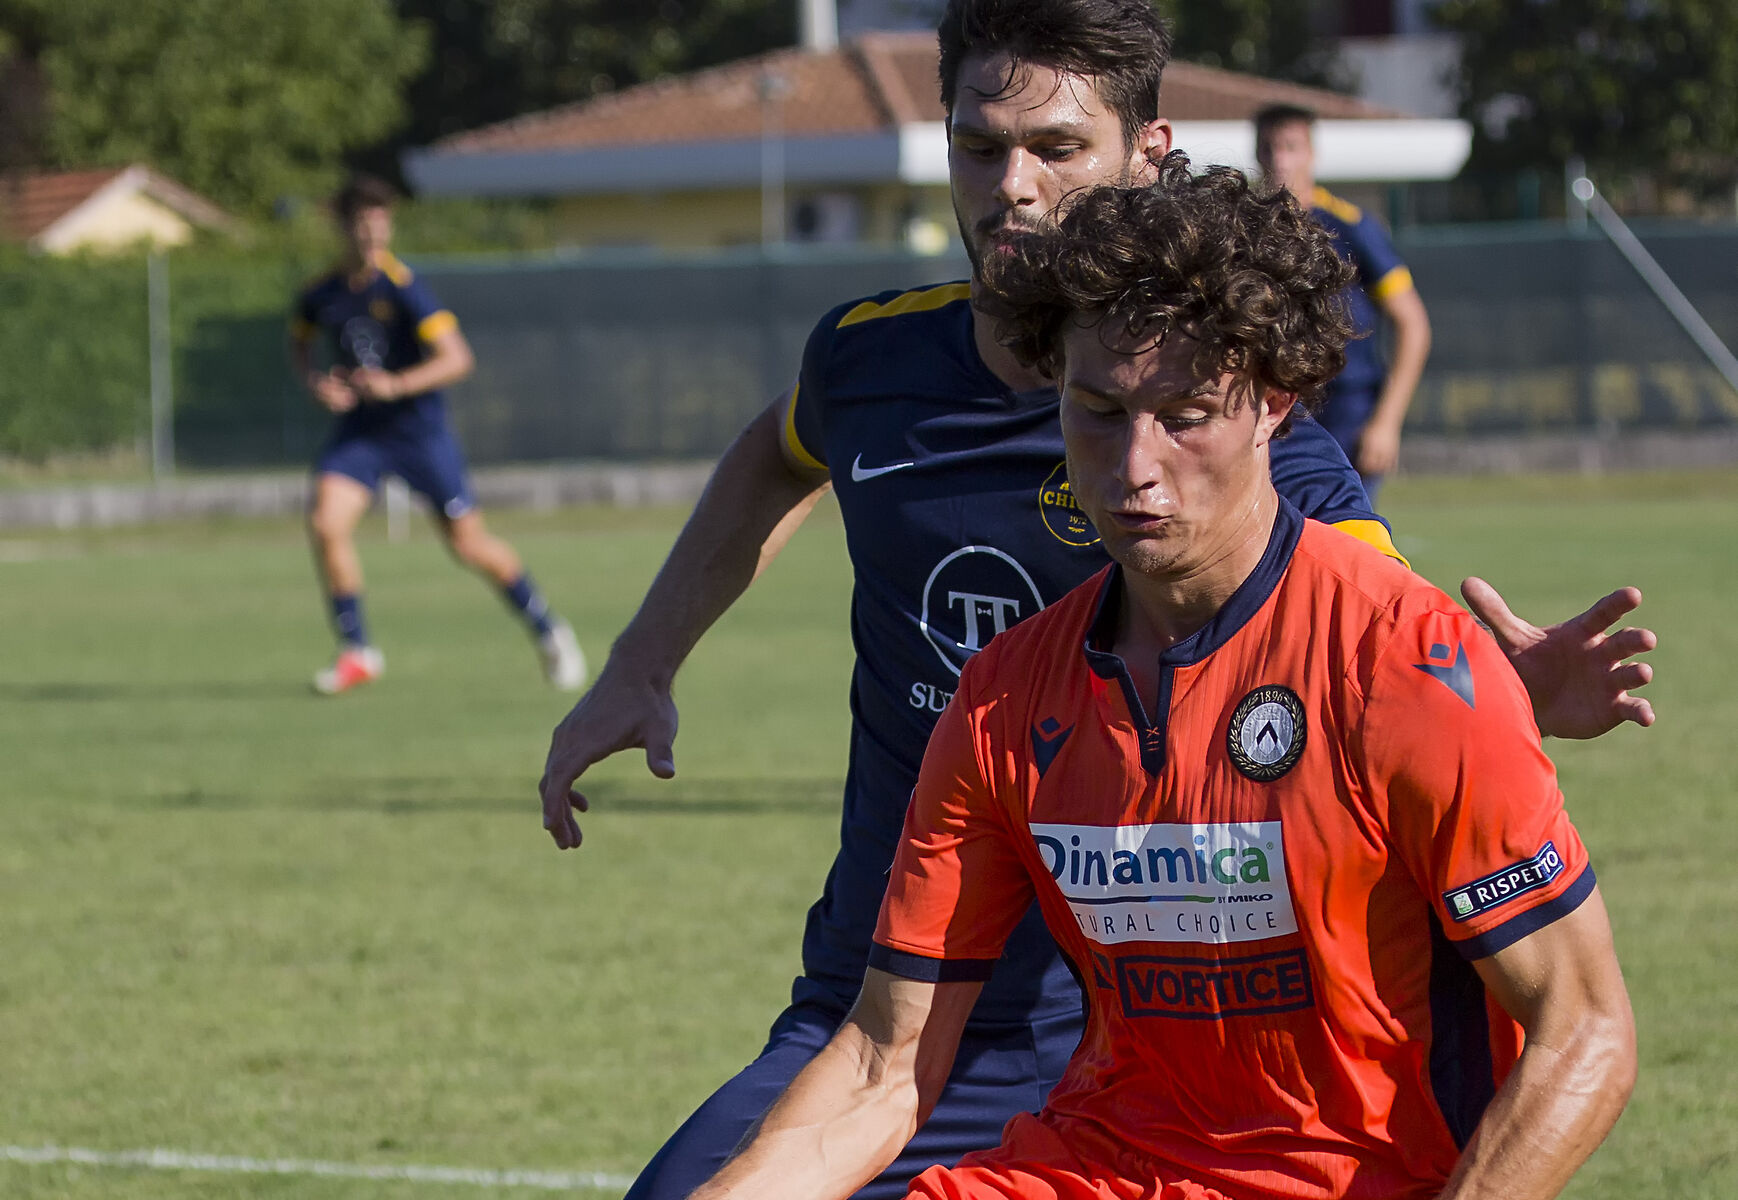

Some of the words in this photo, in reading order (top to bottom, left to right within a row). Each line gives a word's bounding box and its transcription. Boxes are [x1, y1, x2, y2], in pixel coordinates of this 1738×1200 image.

[1044, 491, 1076, 509] CHI
[1260, 690, 1283, 703] 1896
[1476, 850, 1559, 903] RISPETTO
[1228, 893, 1273, 903] MIKO
[1075, 912, 1155, 935] TURAL
[1177, 911, 1277, 934] CHOICE
[1127, 962, 1304, 1006] VORTICE
